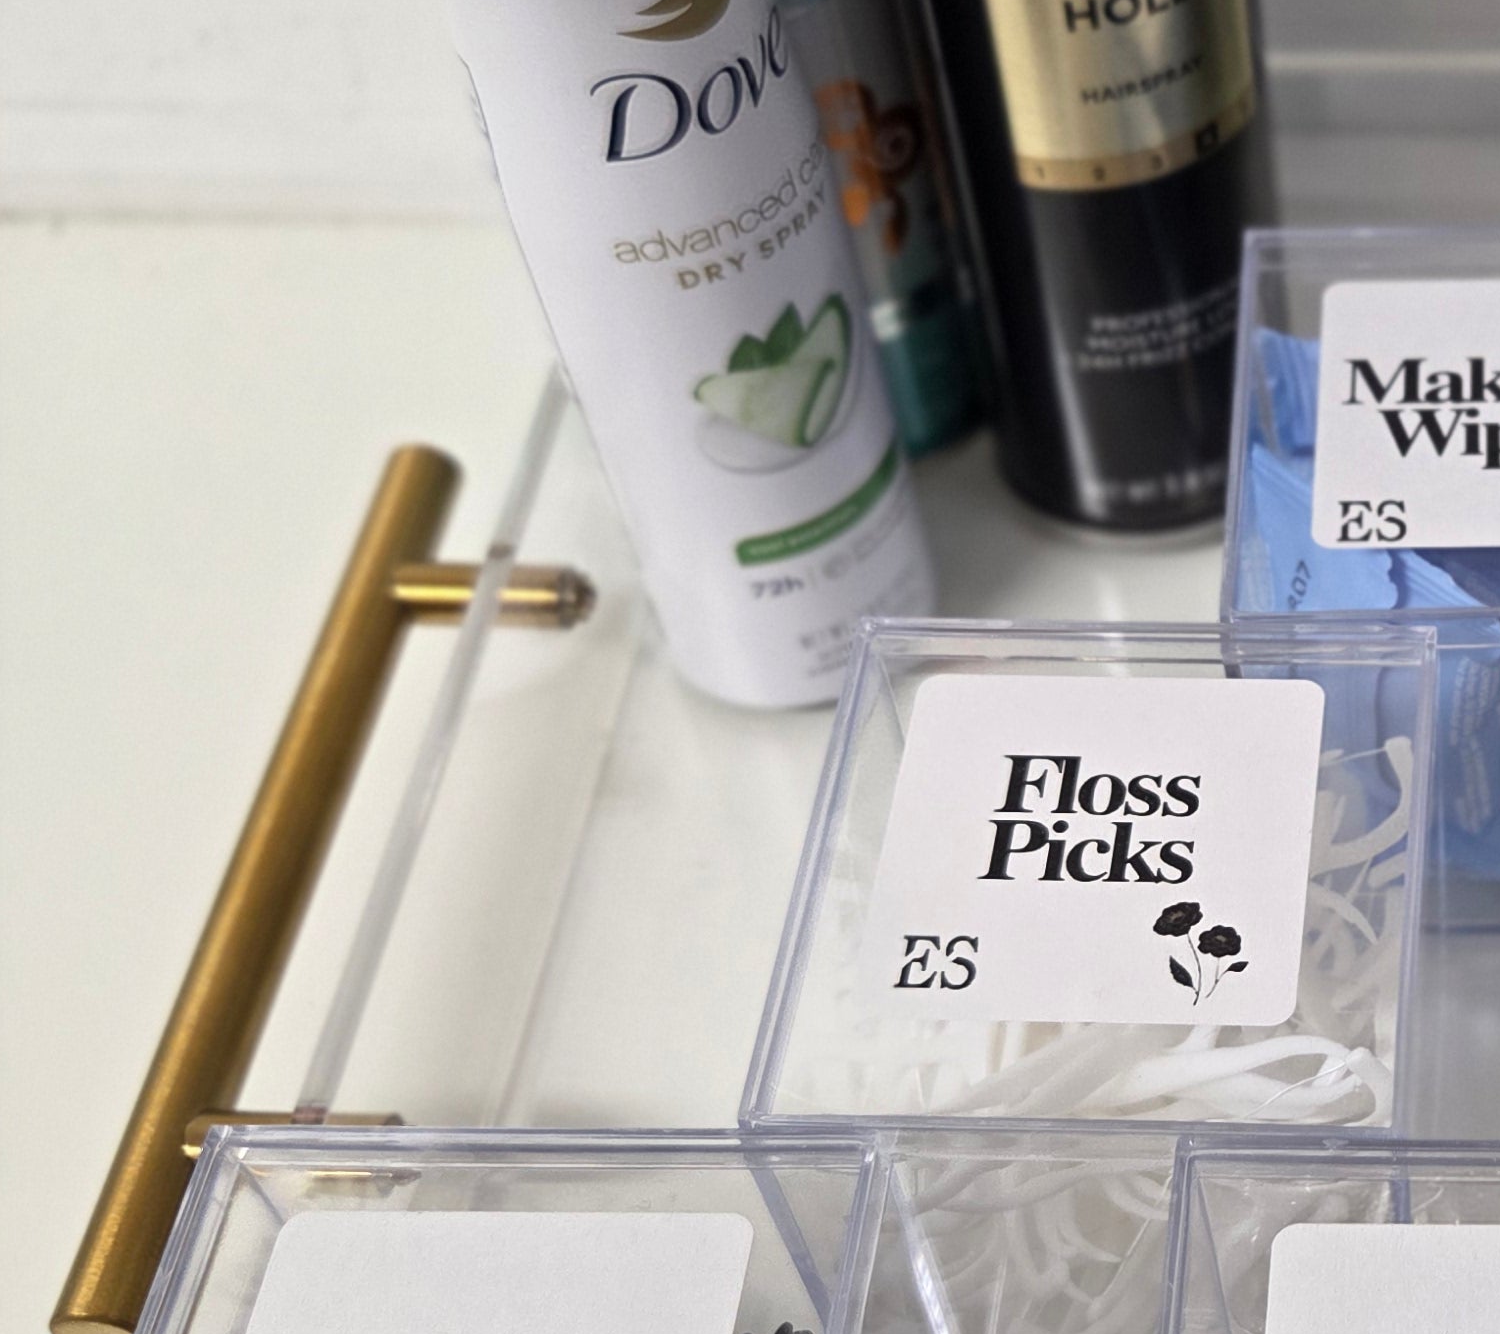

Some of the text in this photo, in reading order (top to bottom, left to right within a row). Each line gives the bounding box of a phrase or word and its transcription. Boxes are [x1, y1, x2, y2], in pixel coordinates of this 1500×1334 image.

[590, 4, 789, 163] Dove
[613, 169, 799, 264] advanced
[676, 182, 827, 290] DRY SPRAY
[1336, 500, 1407, 543] ES
[993, 753, 1202, 817] Floss
[976, 819, 1195, 884] Picks
[893, 935, 979, 990] ES
